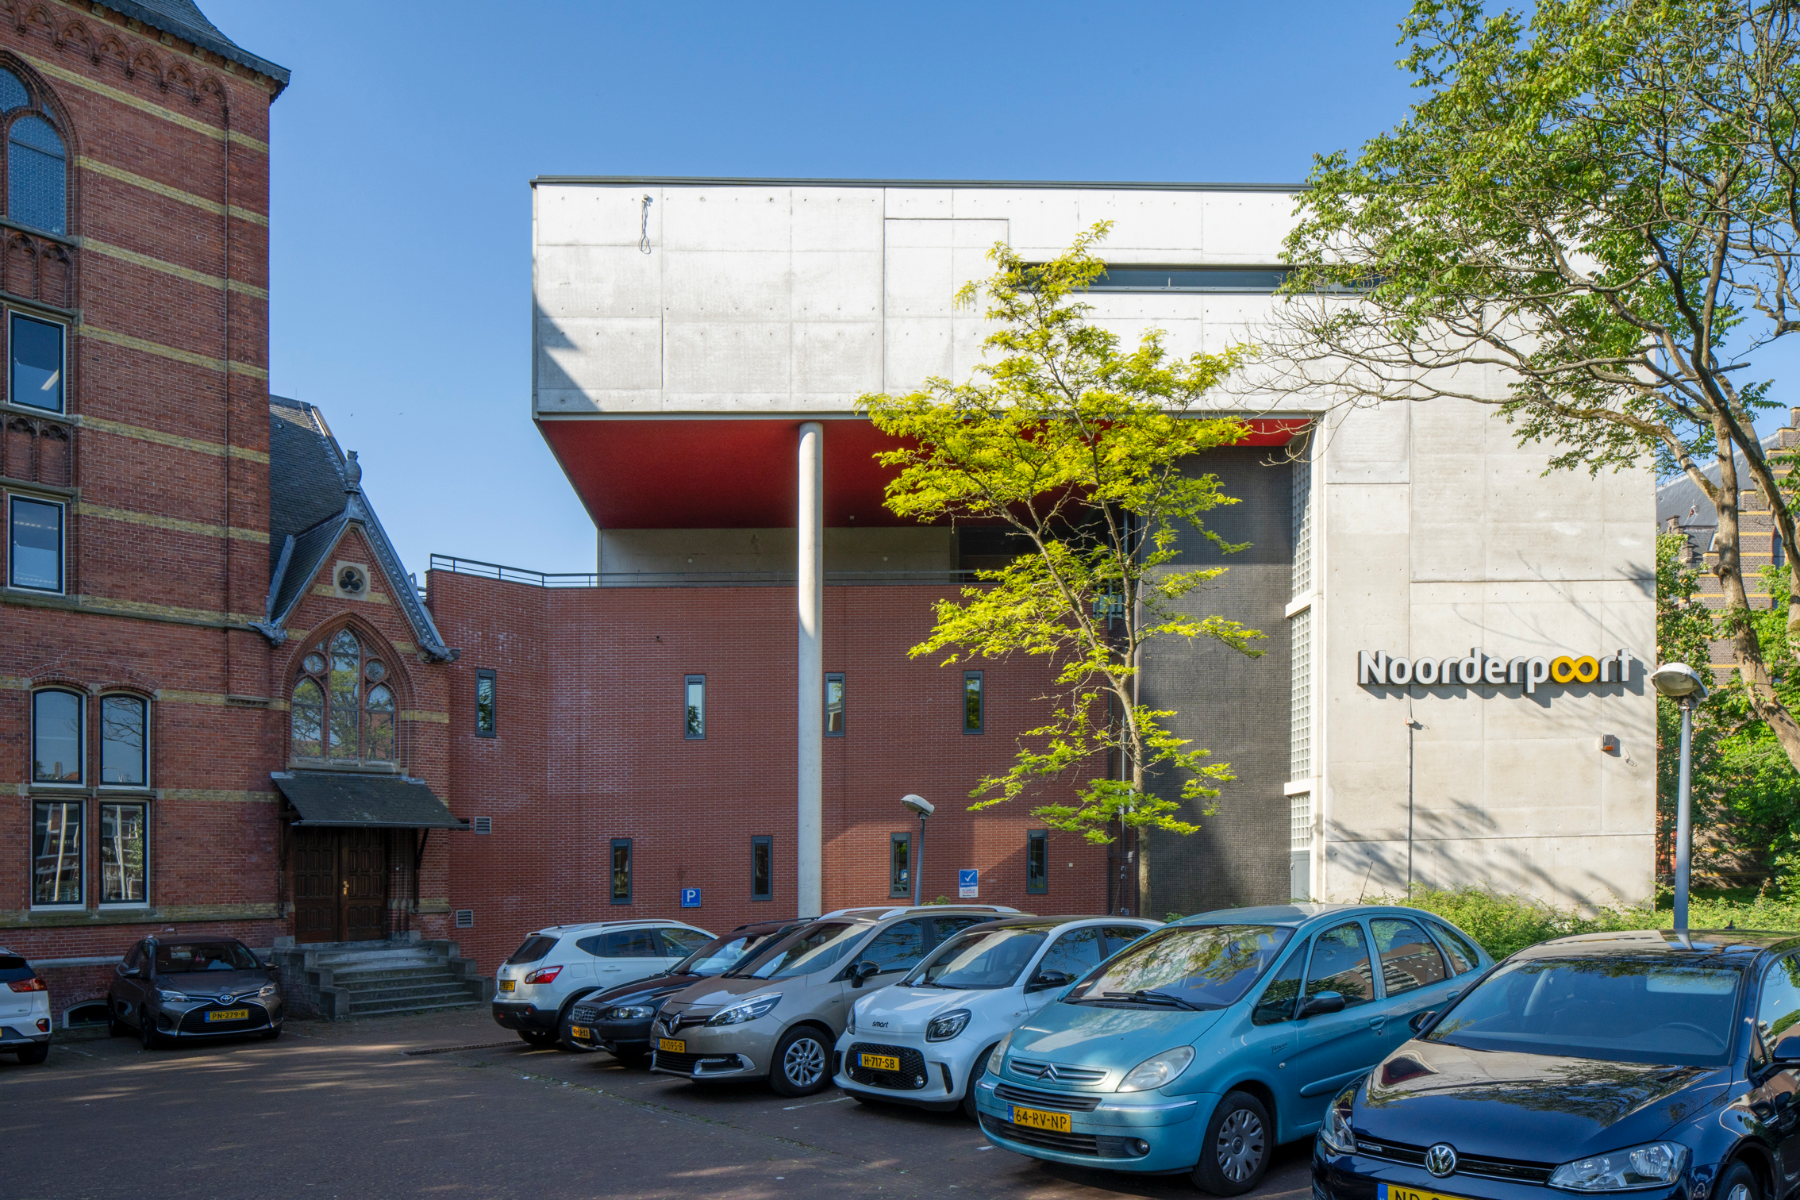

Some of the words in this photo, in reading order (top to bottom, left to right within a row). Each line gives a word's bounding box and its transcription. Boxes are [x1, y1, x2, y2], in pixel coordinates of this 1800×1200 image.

[1358, 647, 1633, 693] Noorderpoort
[686, 889, 696, 903] P
[212, 1011, 246, 1020] PN-279-R
[864, 1055, 895, 1069] H-717-SB
[1016, 1109, 1067, 1130] 64-RV-NP
